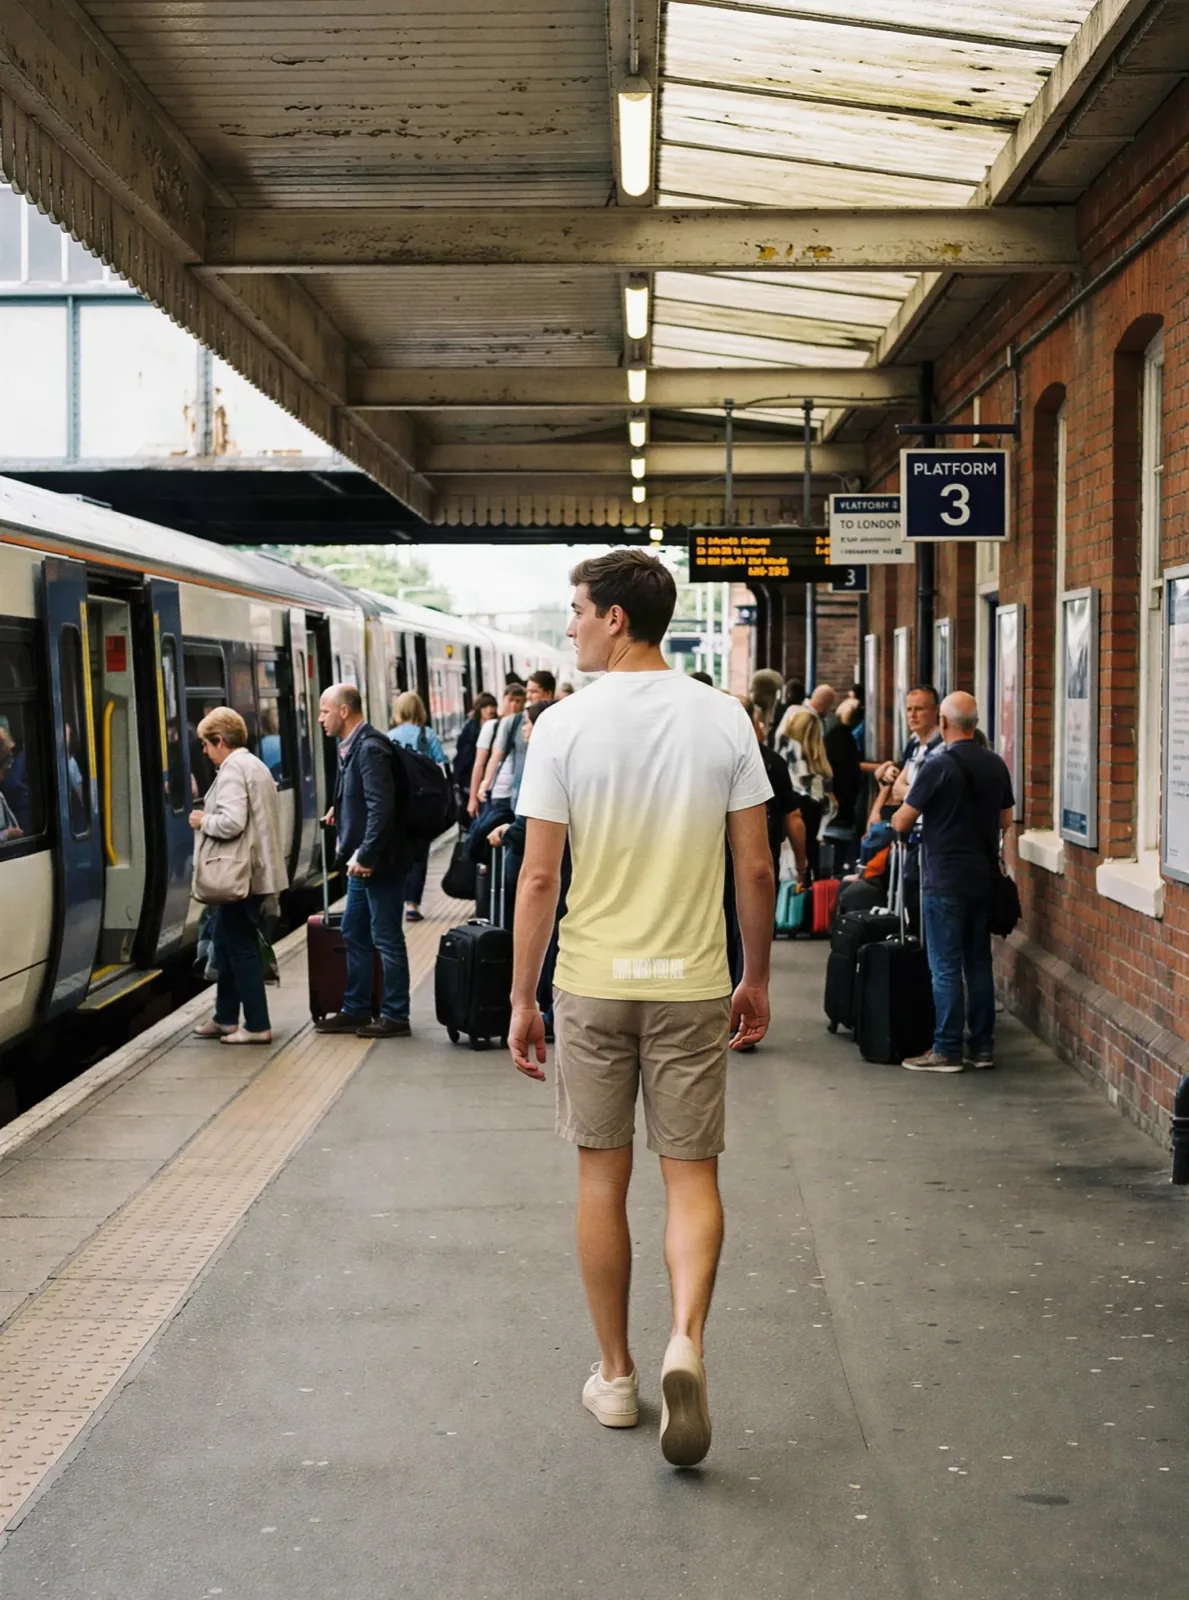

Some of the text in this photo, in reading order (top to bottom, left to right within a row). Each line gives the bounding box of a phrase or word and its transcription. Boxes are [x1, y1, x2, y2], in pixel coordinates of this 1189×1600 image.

[913, 462, 997, 476] PLATFORM
[939, 483, 971, 526] 3
[840, 519, 901, 529] TO LONDON
[844, 568, 856, 586] 3
